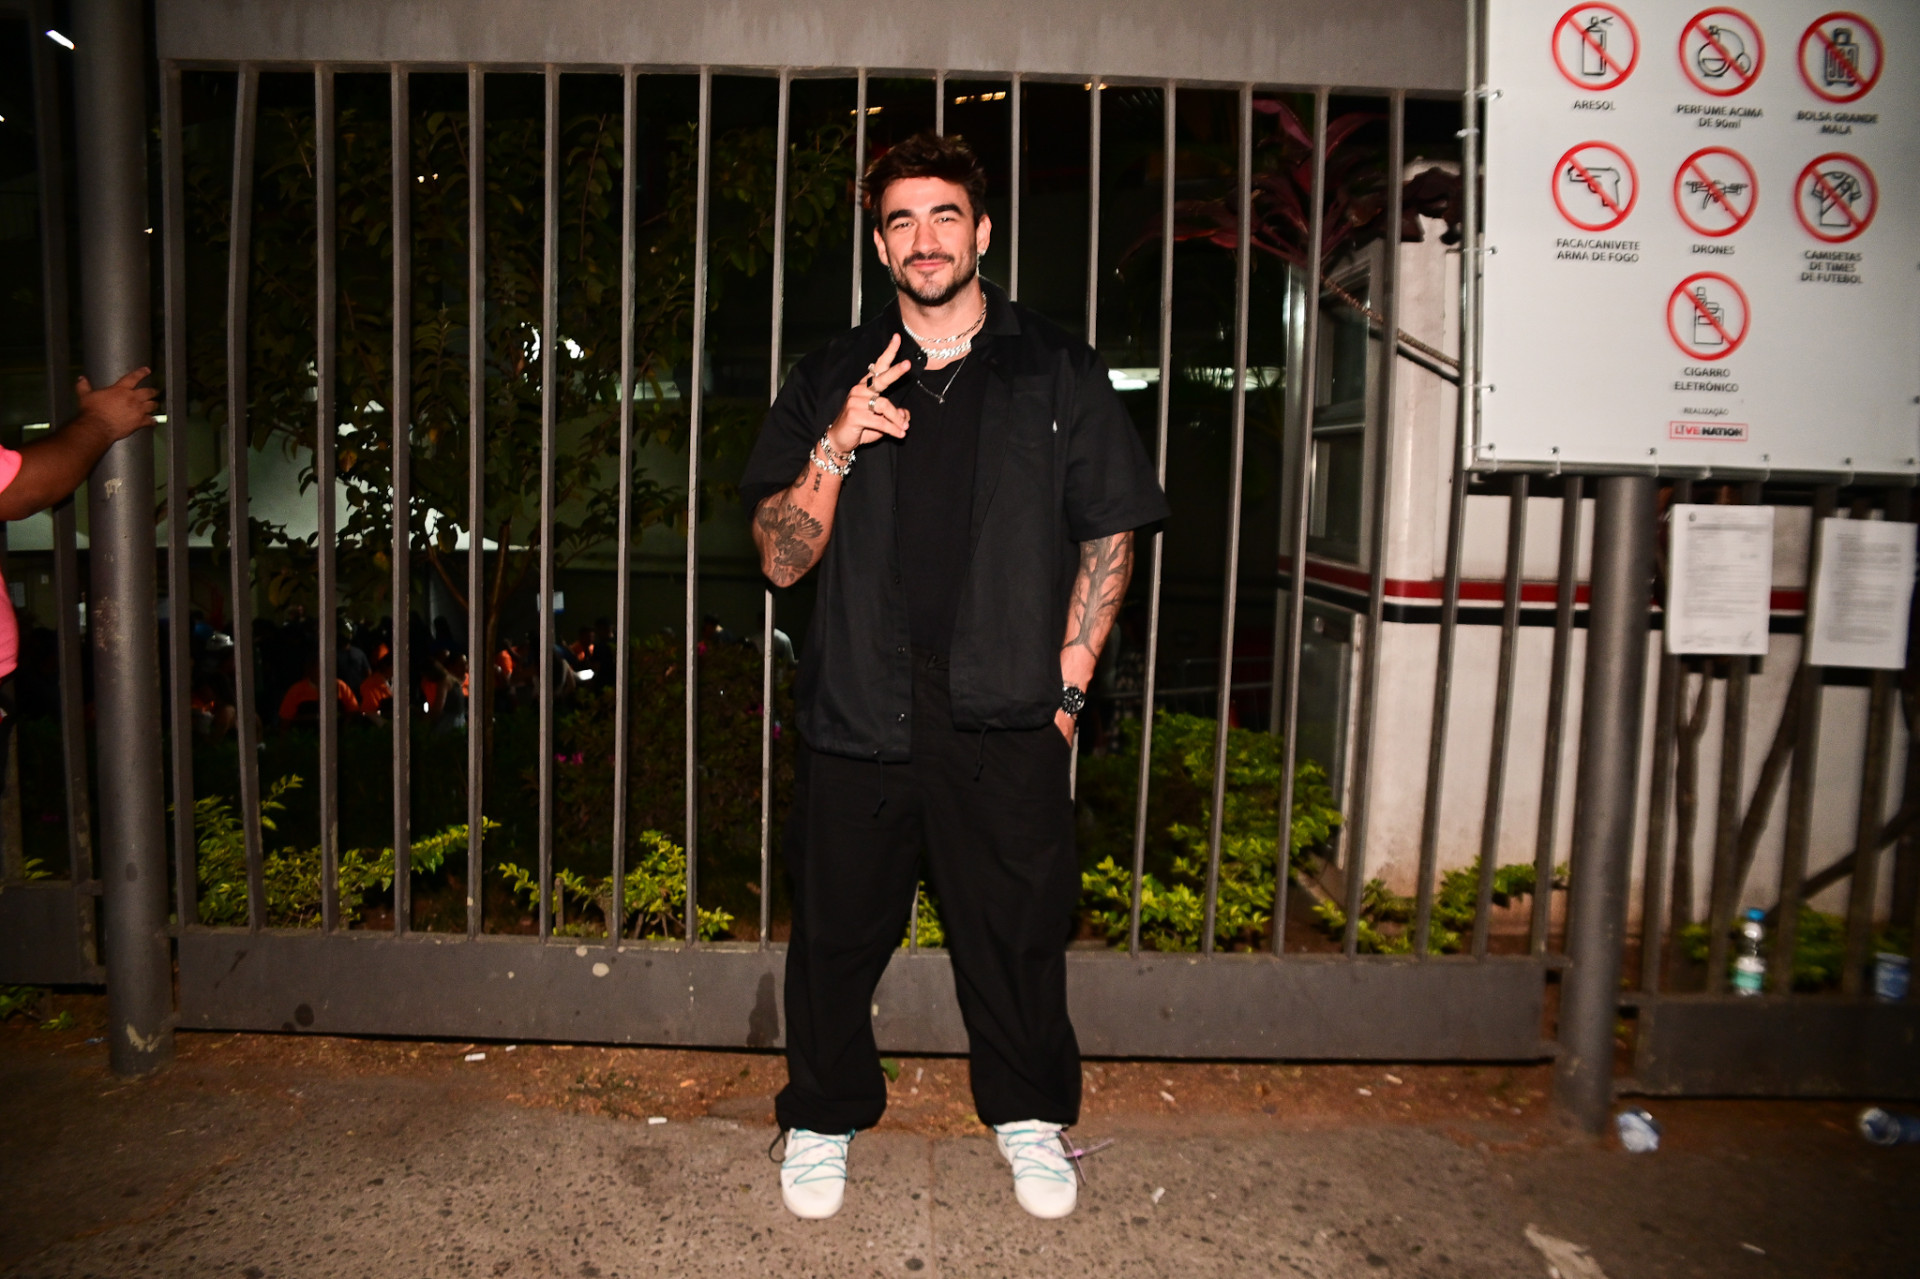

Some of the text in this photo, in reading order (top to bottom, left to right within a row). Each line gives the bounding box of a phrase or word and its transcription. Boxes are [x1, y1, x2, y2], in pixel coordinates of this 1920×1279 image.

[1573, 100, 1616, 110] ARESOL
[1677, 104, 1764, 118] PERFUME ACIMA
[1797, 110, 1879, 124] BOLSA GRANDE
[1698, 118, 1713, 128] DE
[1821, 125, 1852, 135] MALA
[1556, 238, 1640, 250] FACA/CANIVETE
[1691, 244, 1736, 255] DRONES
[1557, 251, 1640, 262] ARMA DE FOGO
[1804, 250, 1863, 262] CAMISETAS
[1810, 262, 1857, 272] DE TIMES
[1801, 272, 1864, 284] DE FUTEBOL
[1684, 367, 1731, 378] CIGARRO
[1675, 424, 1743, 436] LIVE NATION
